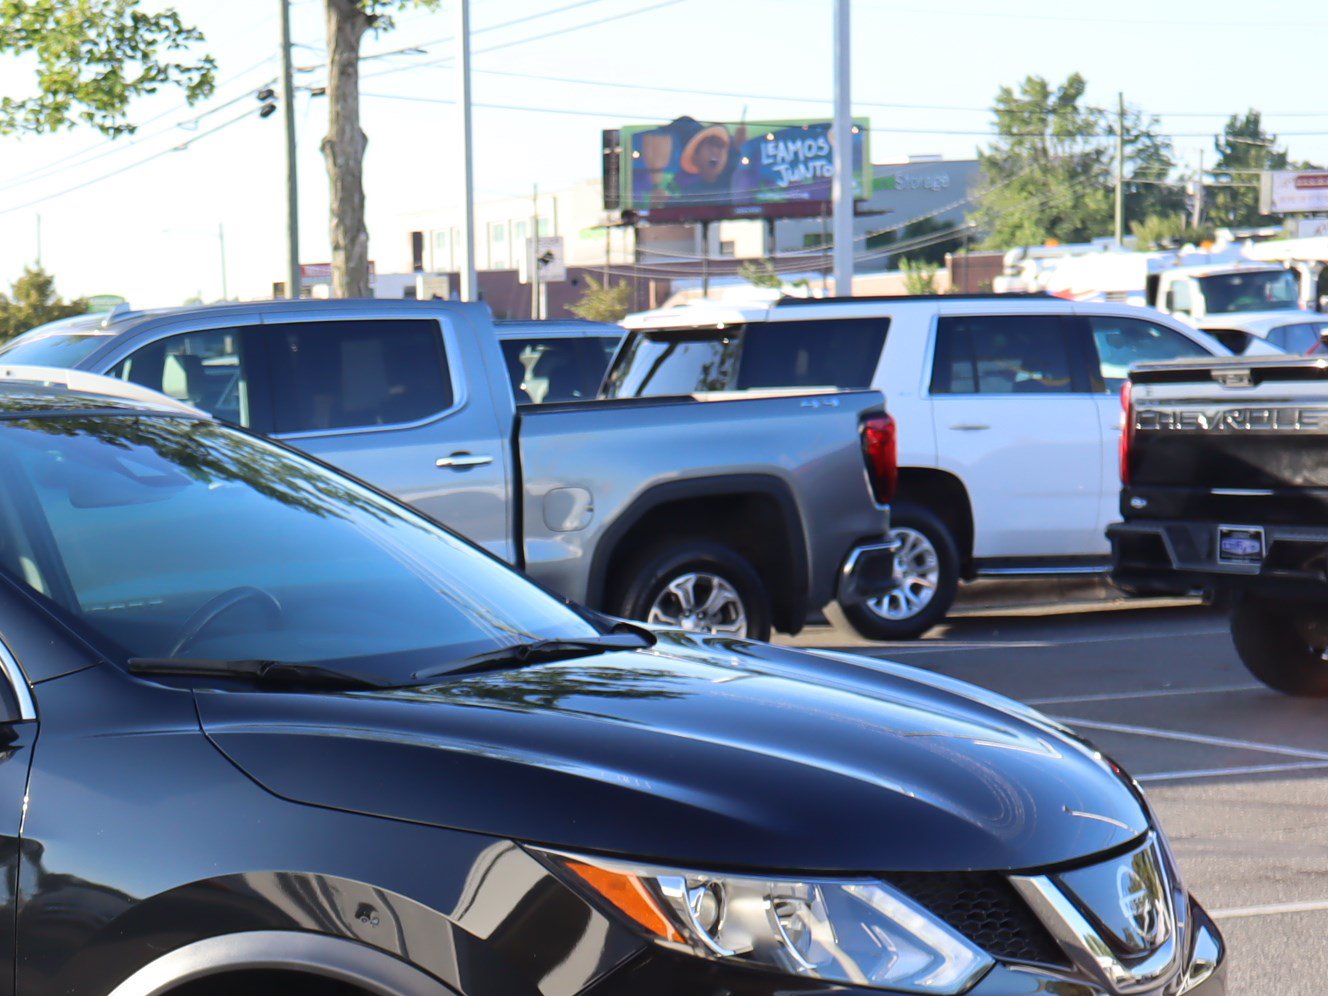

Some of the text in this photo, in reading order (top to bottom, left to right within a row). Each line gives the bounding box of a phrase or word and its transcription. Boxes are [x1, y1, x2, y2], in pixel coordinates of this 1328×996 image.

[760, 136, 829, 164] LEAMOS
[771, 158, 834, 187] JUNTO
[1134, 407, 1328, 431] CHEVROLE
